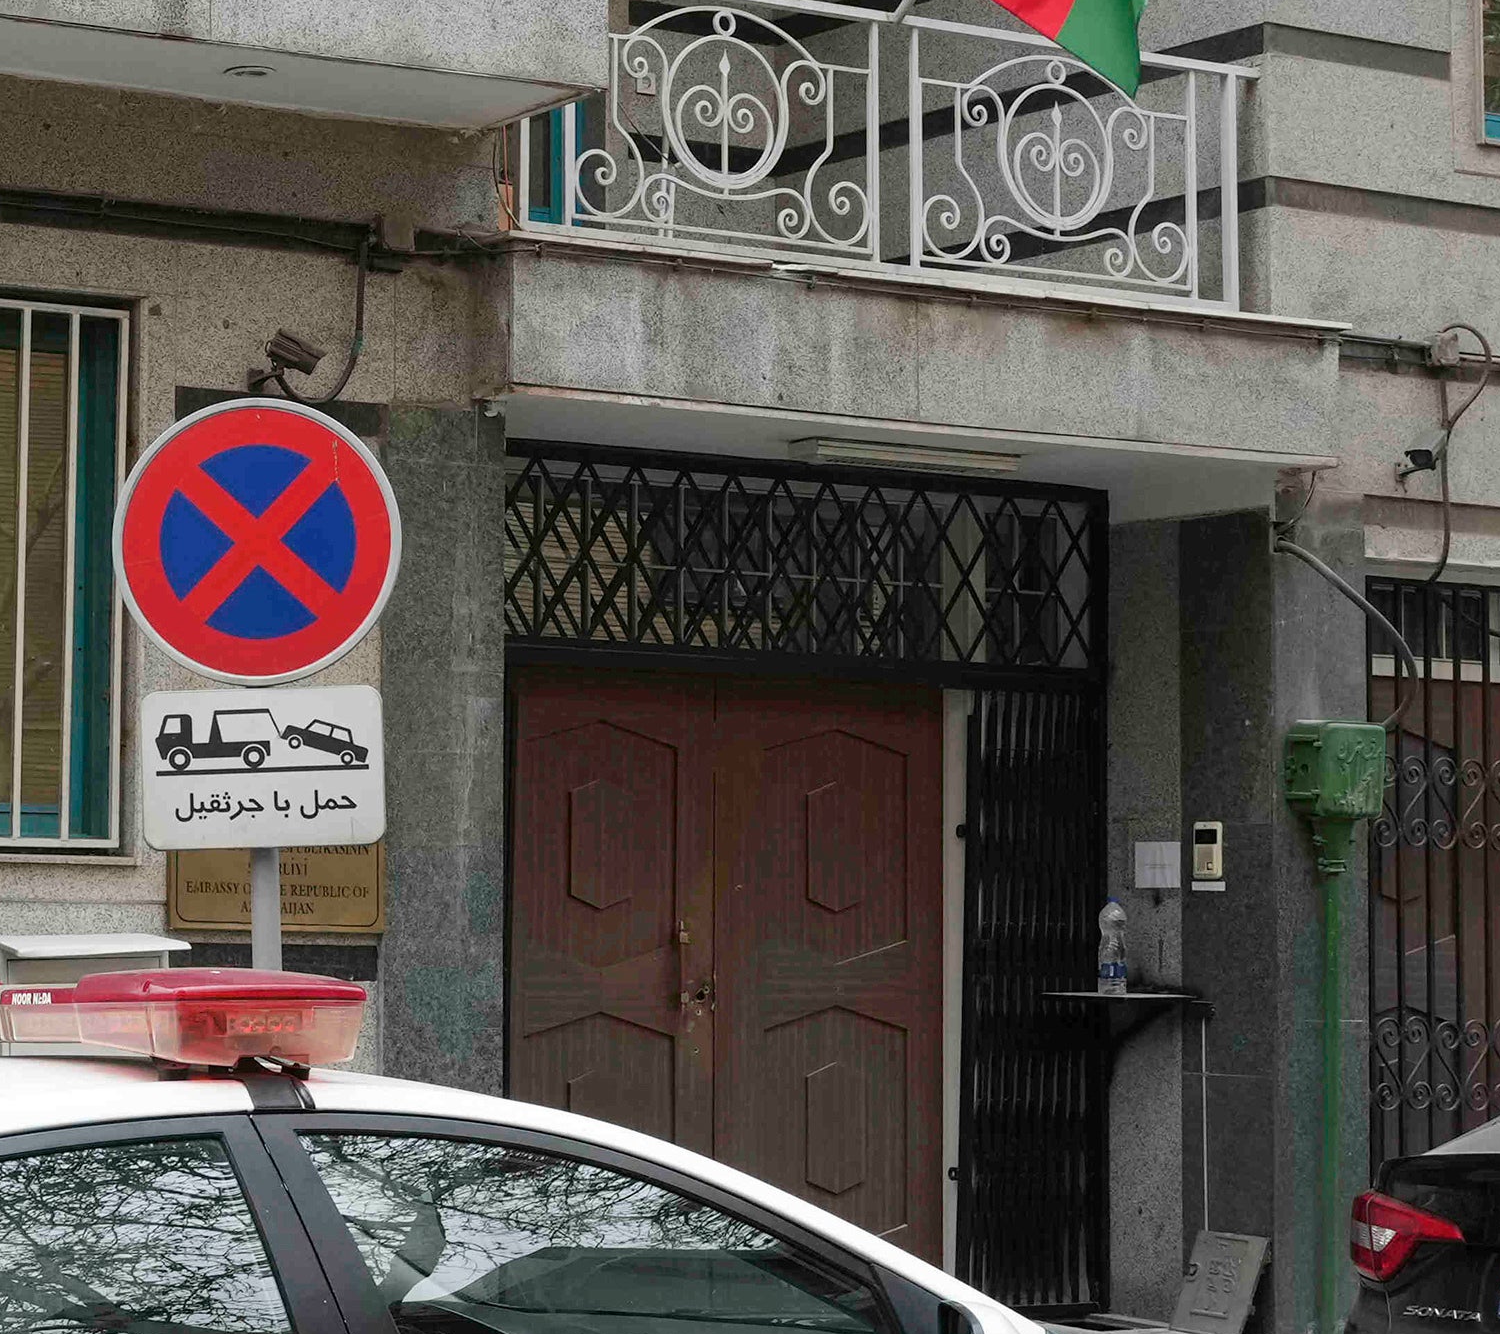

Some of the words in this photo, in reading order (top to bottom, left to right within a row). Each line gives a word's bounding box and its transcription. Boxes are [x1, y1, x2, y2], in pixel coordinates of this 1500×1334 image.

[175, 791, 265, 823] جرثقیل
[273, 790, 291, 818] با
[300, 789, 358, 819] حمل
[186, 880, 240, 895] EMBASSY
[291, 884, 350, 898] REPUBLIC
[12, 993, 32, 1005] NOOR
